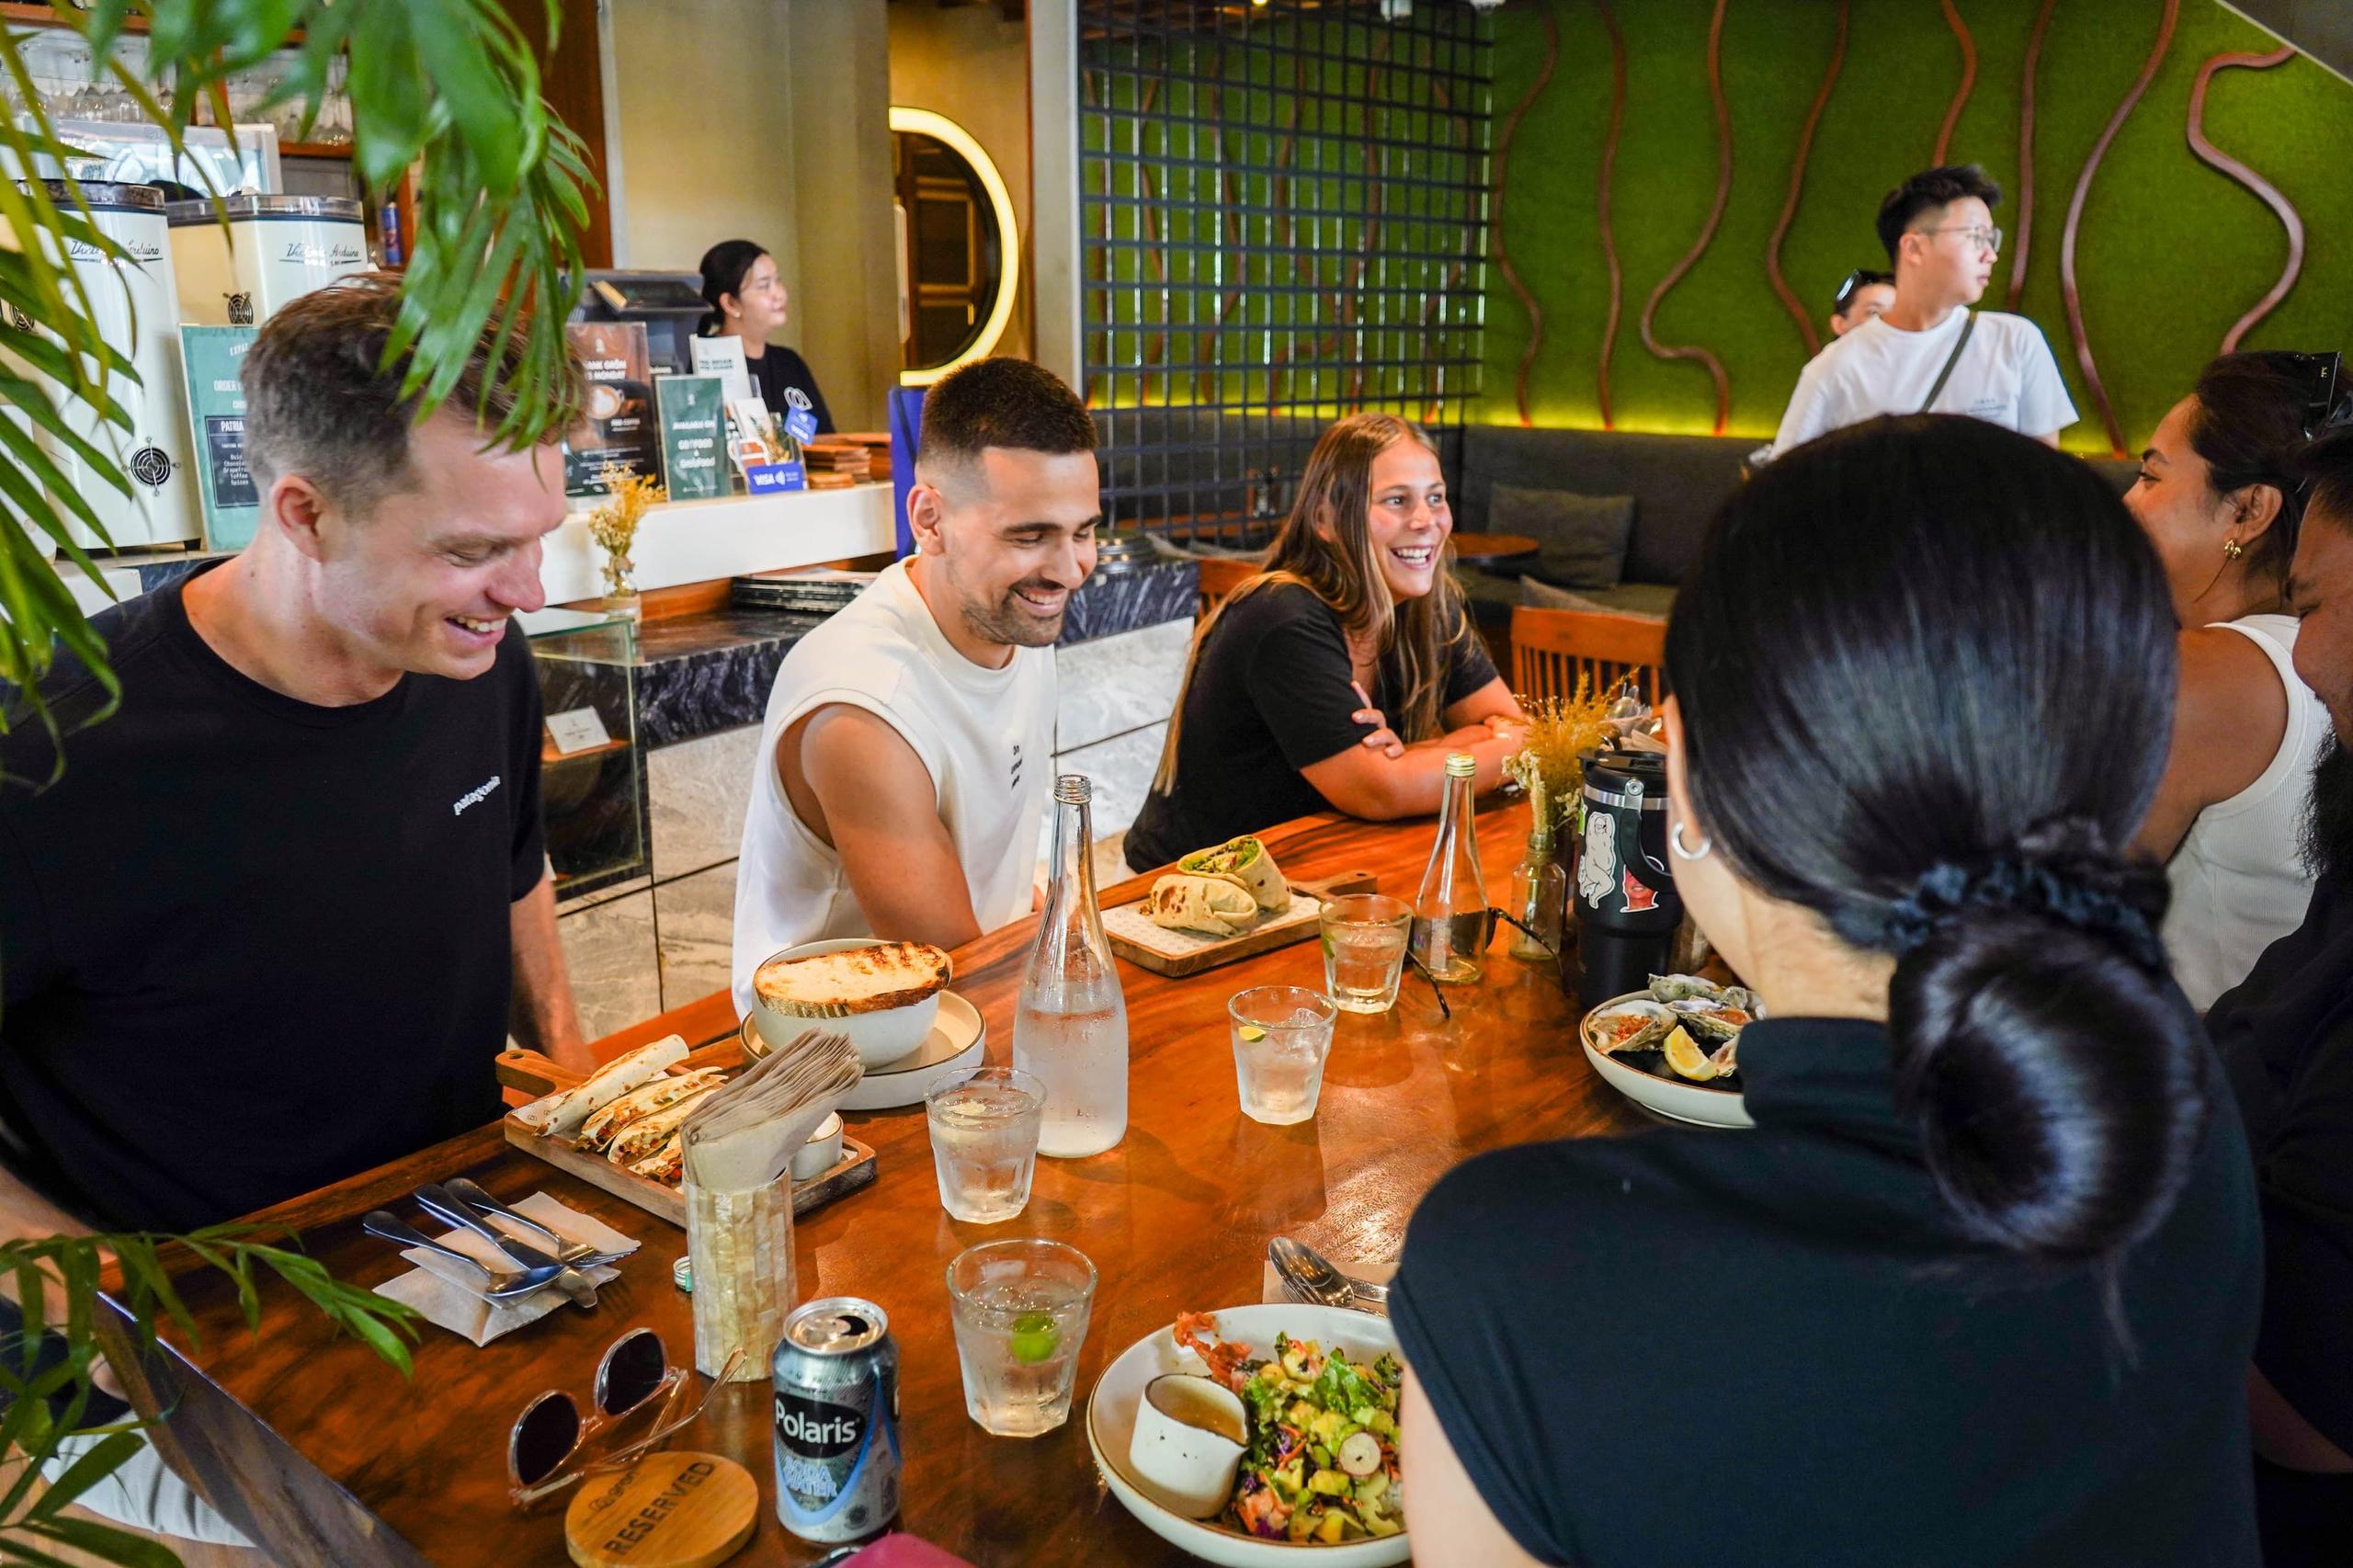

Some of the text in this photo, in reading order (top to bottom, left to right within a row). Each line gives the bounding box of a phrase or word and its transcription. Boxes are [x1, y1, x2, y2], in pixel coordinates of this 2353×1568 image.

[213, 380, 237, 392] ORDER
[221, 421, 244, 432] PATRIA
[753, 473, 776, 486] VISA
[774, 1397, 857, 1445] Polaris
[602, 1460, 715, 1556] RESERVED
